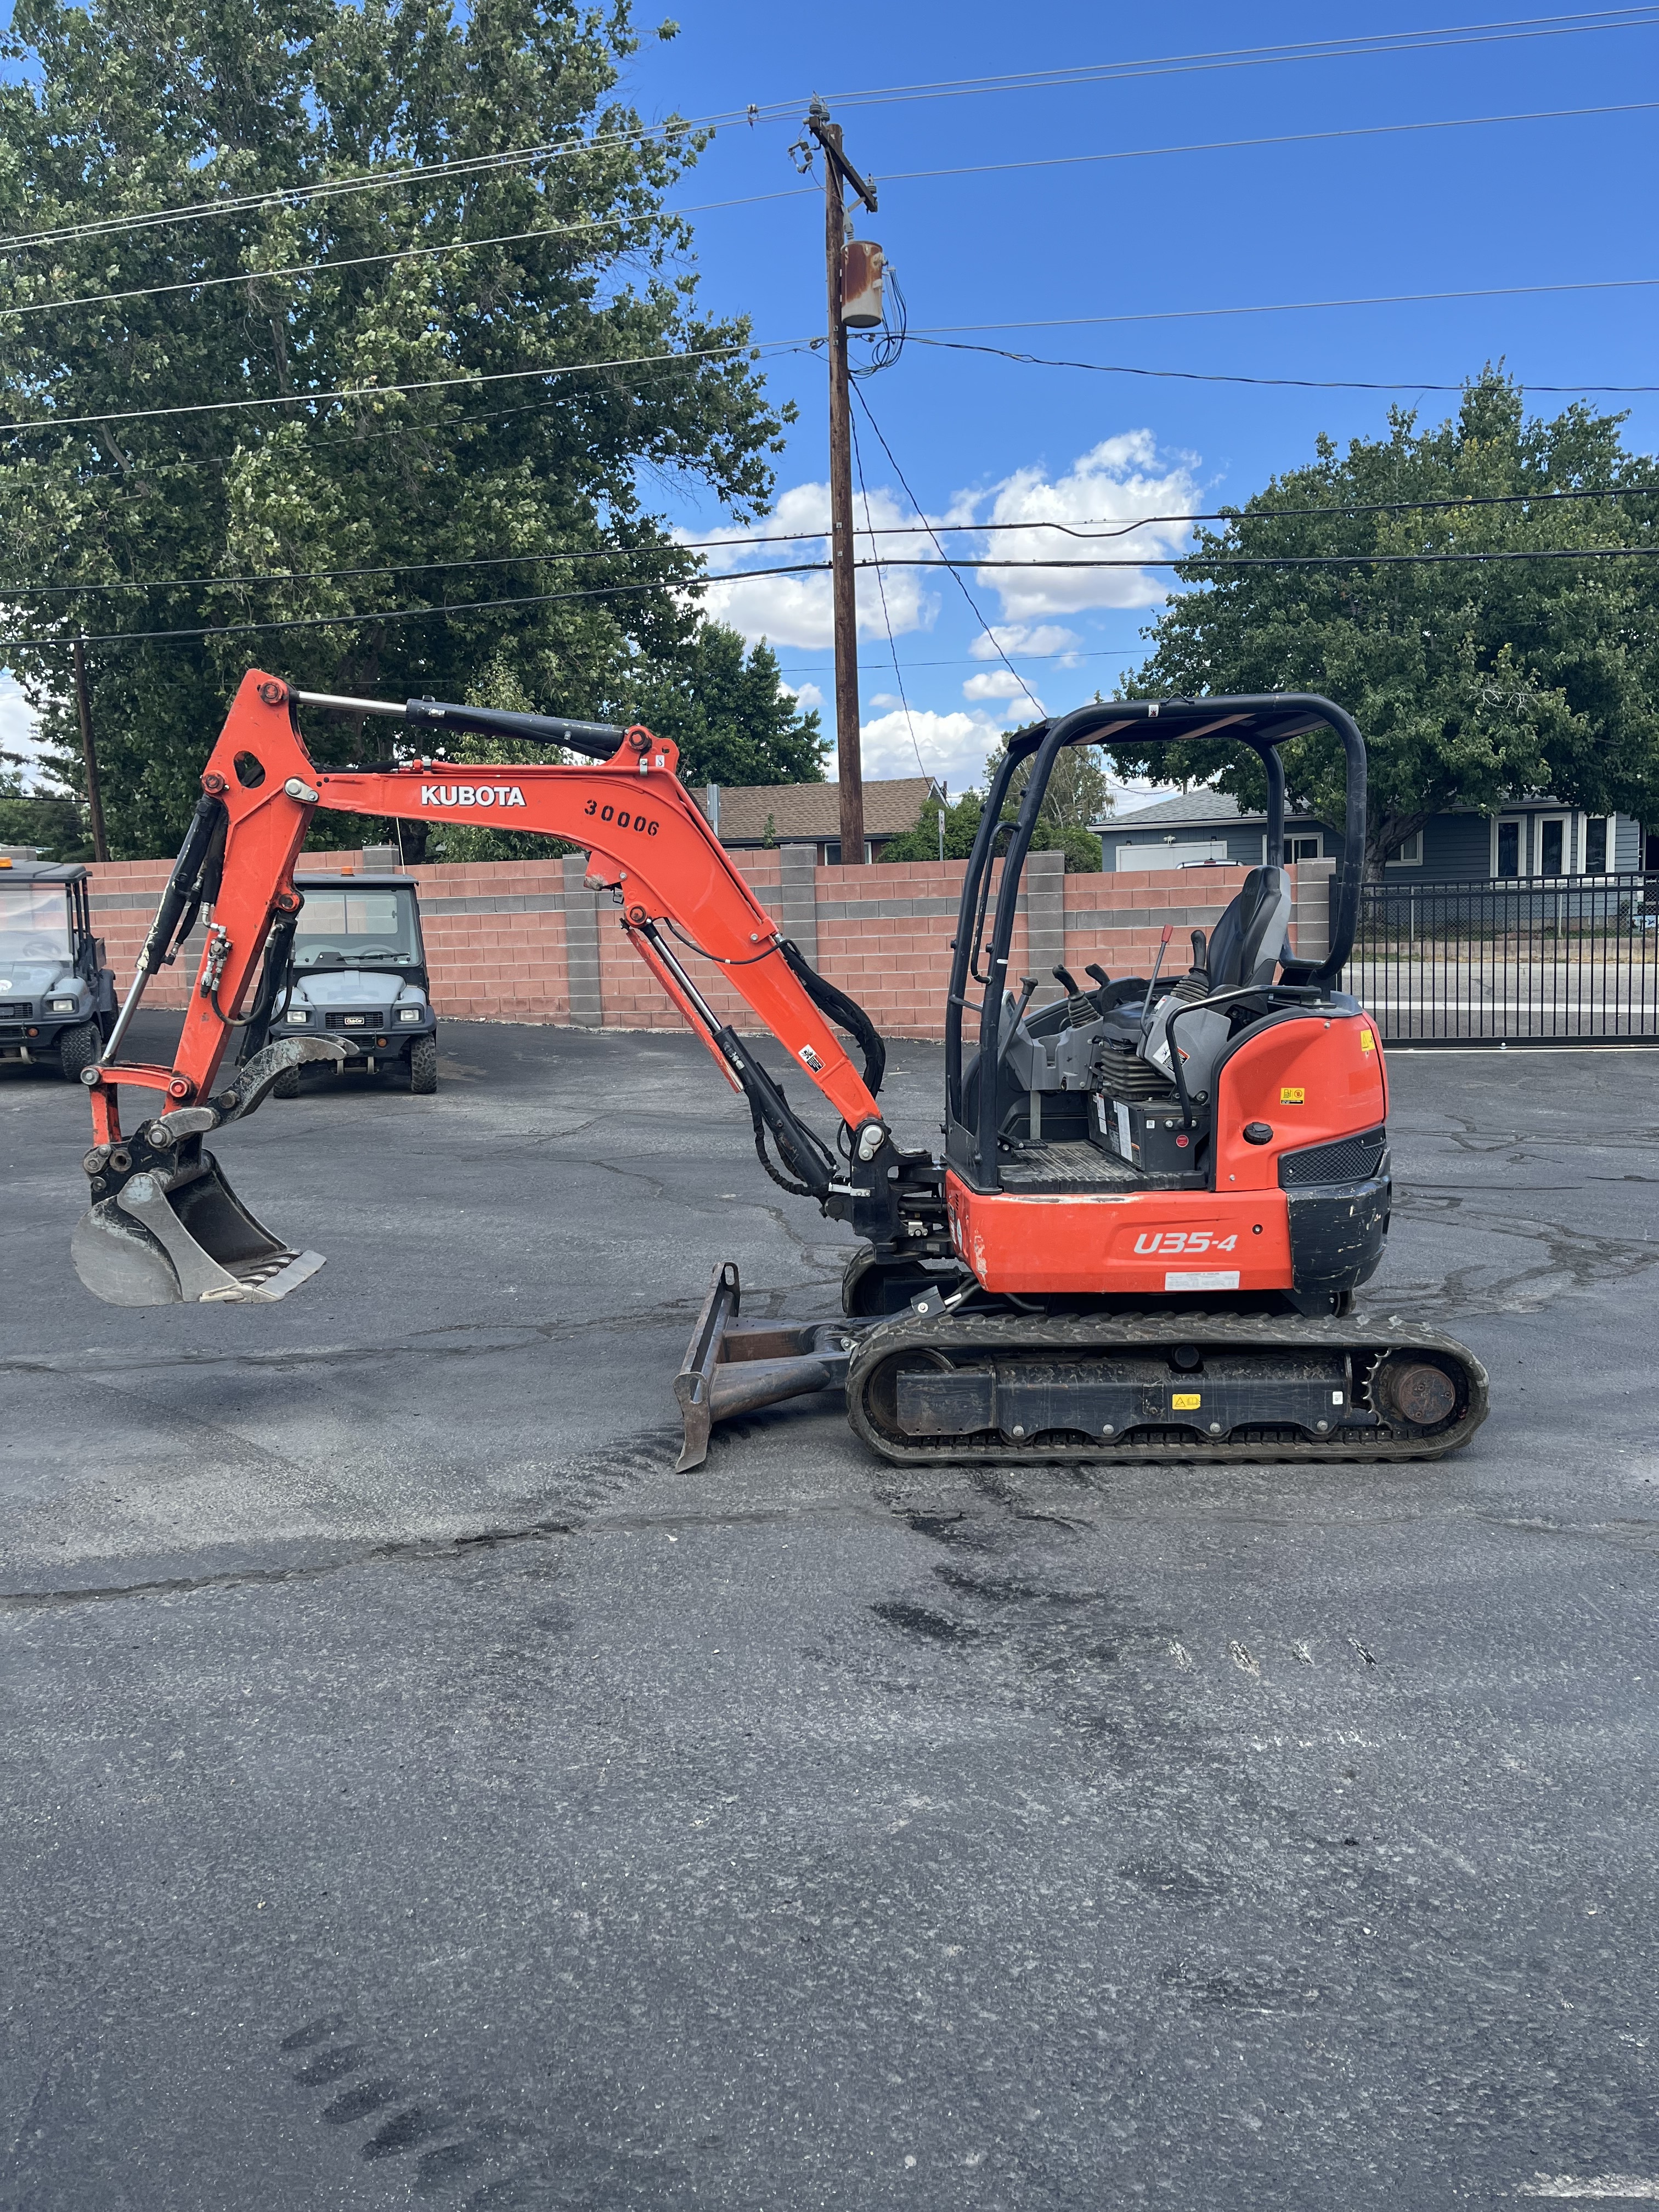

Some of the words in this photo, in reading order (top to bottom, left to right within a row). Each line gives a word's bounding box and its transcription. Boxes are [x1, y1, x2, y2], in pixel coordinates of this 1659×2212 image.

[421, 785, 527, 807] KUBOTA
[584, 799, 659, 836] 30006
[1133, 1231, 1238, 1254] U35-4
